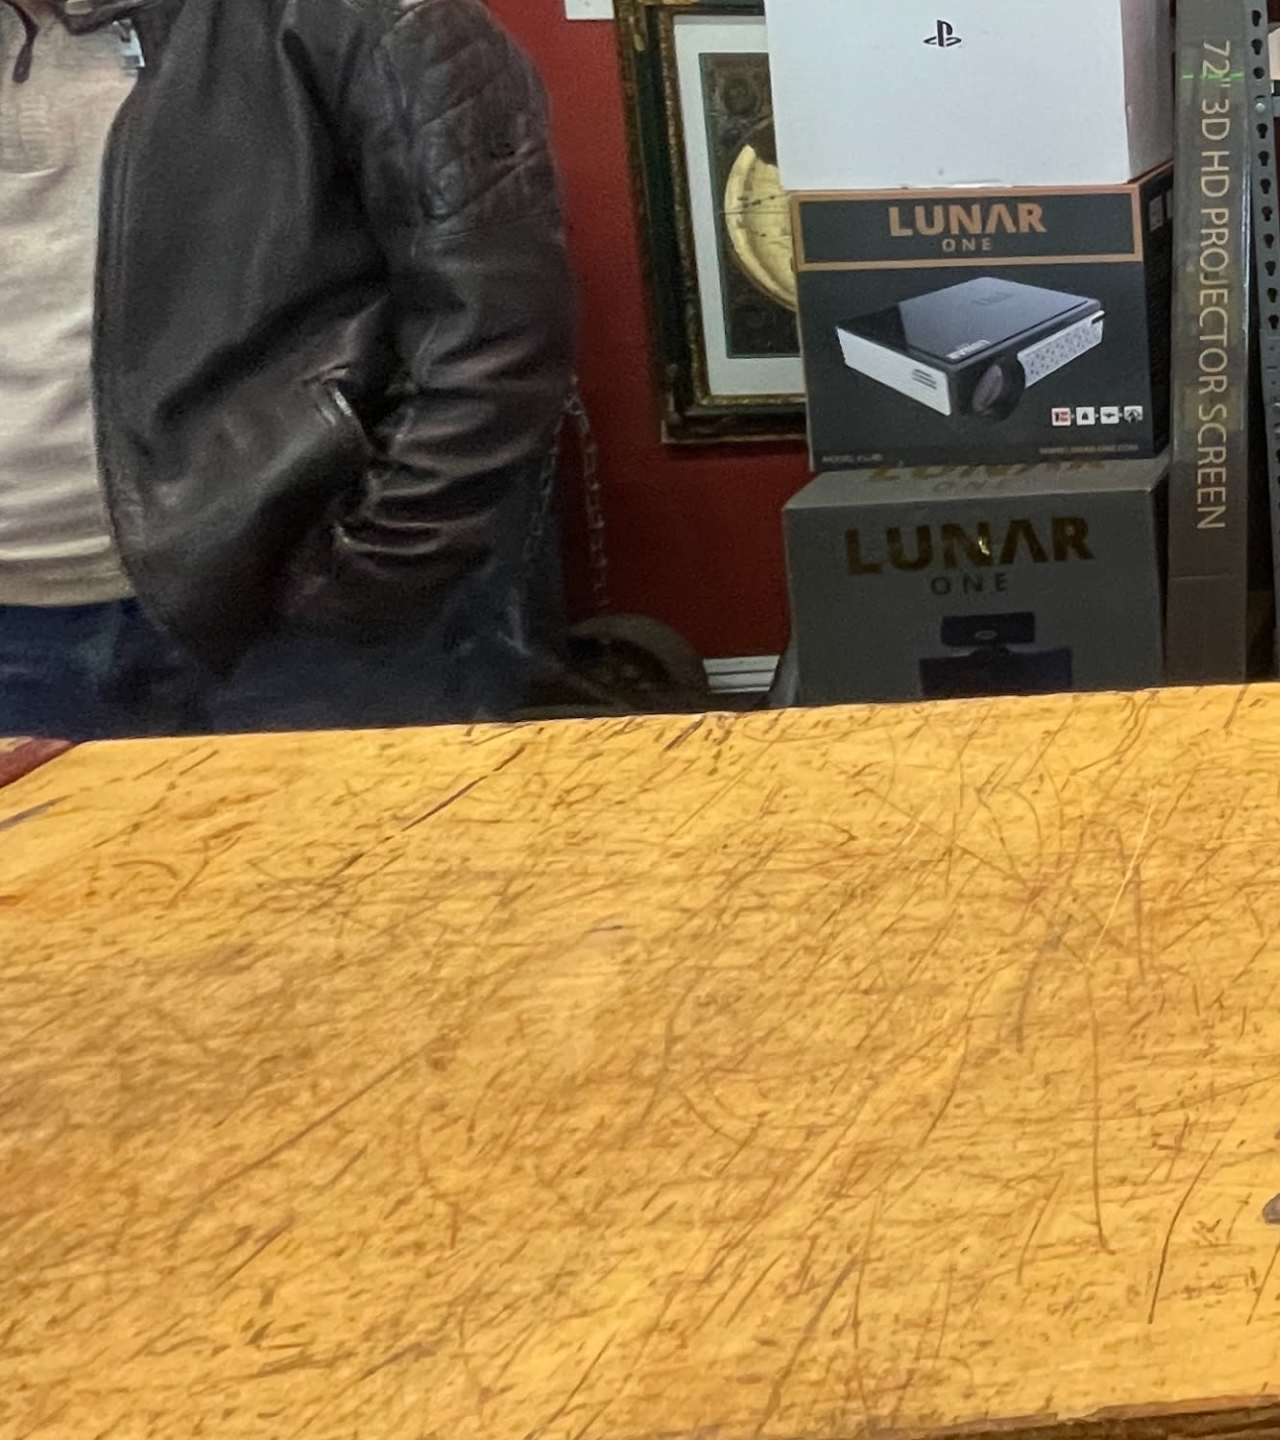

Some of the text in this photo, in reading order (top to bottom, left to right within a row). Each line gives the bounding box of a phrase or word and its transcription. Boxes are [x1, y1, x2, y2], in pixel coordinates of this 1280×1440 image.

[1201, 98, 1231, 142] 3D
[1200, 151, 1230, 198] HD
[888, 202, 1048, 238] LUNAR
[941, 238, 993, 253] ONE
[1198, 208, 1229, 394] PROJECTOR
[1196, 405, 1227, 531] SCREEN
[845, 516, 1097, 576] LUNAR
[931, 572, 1008, 596] ONE
